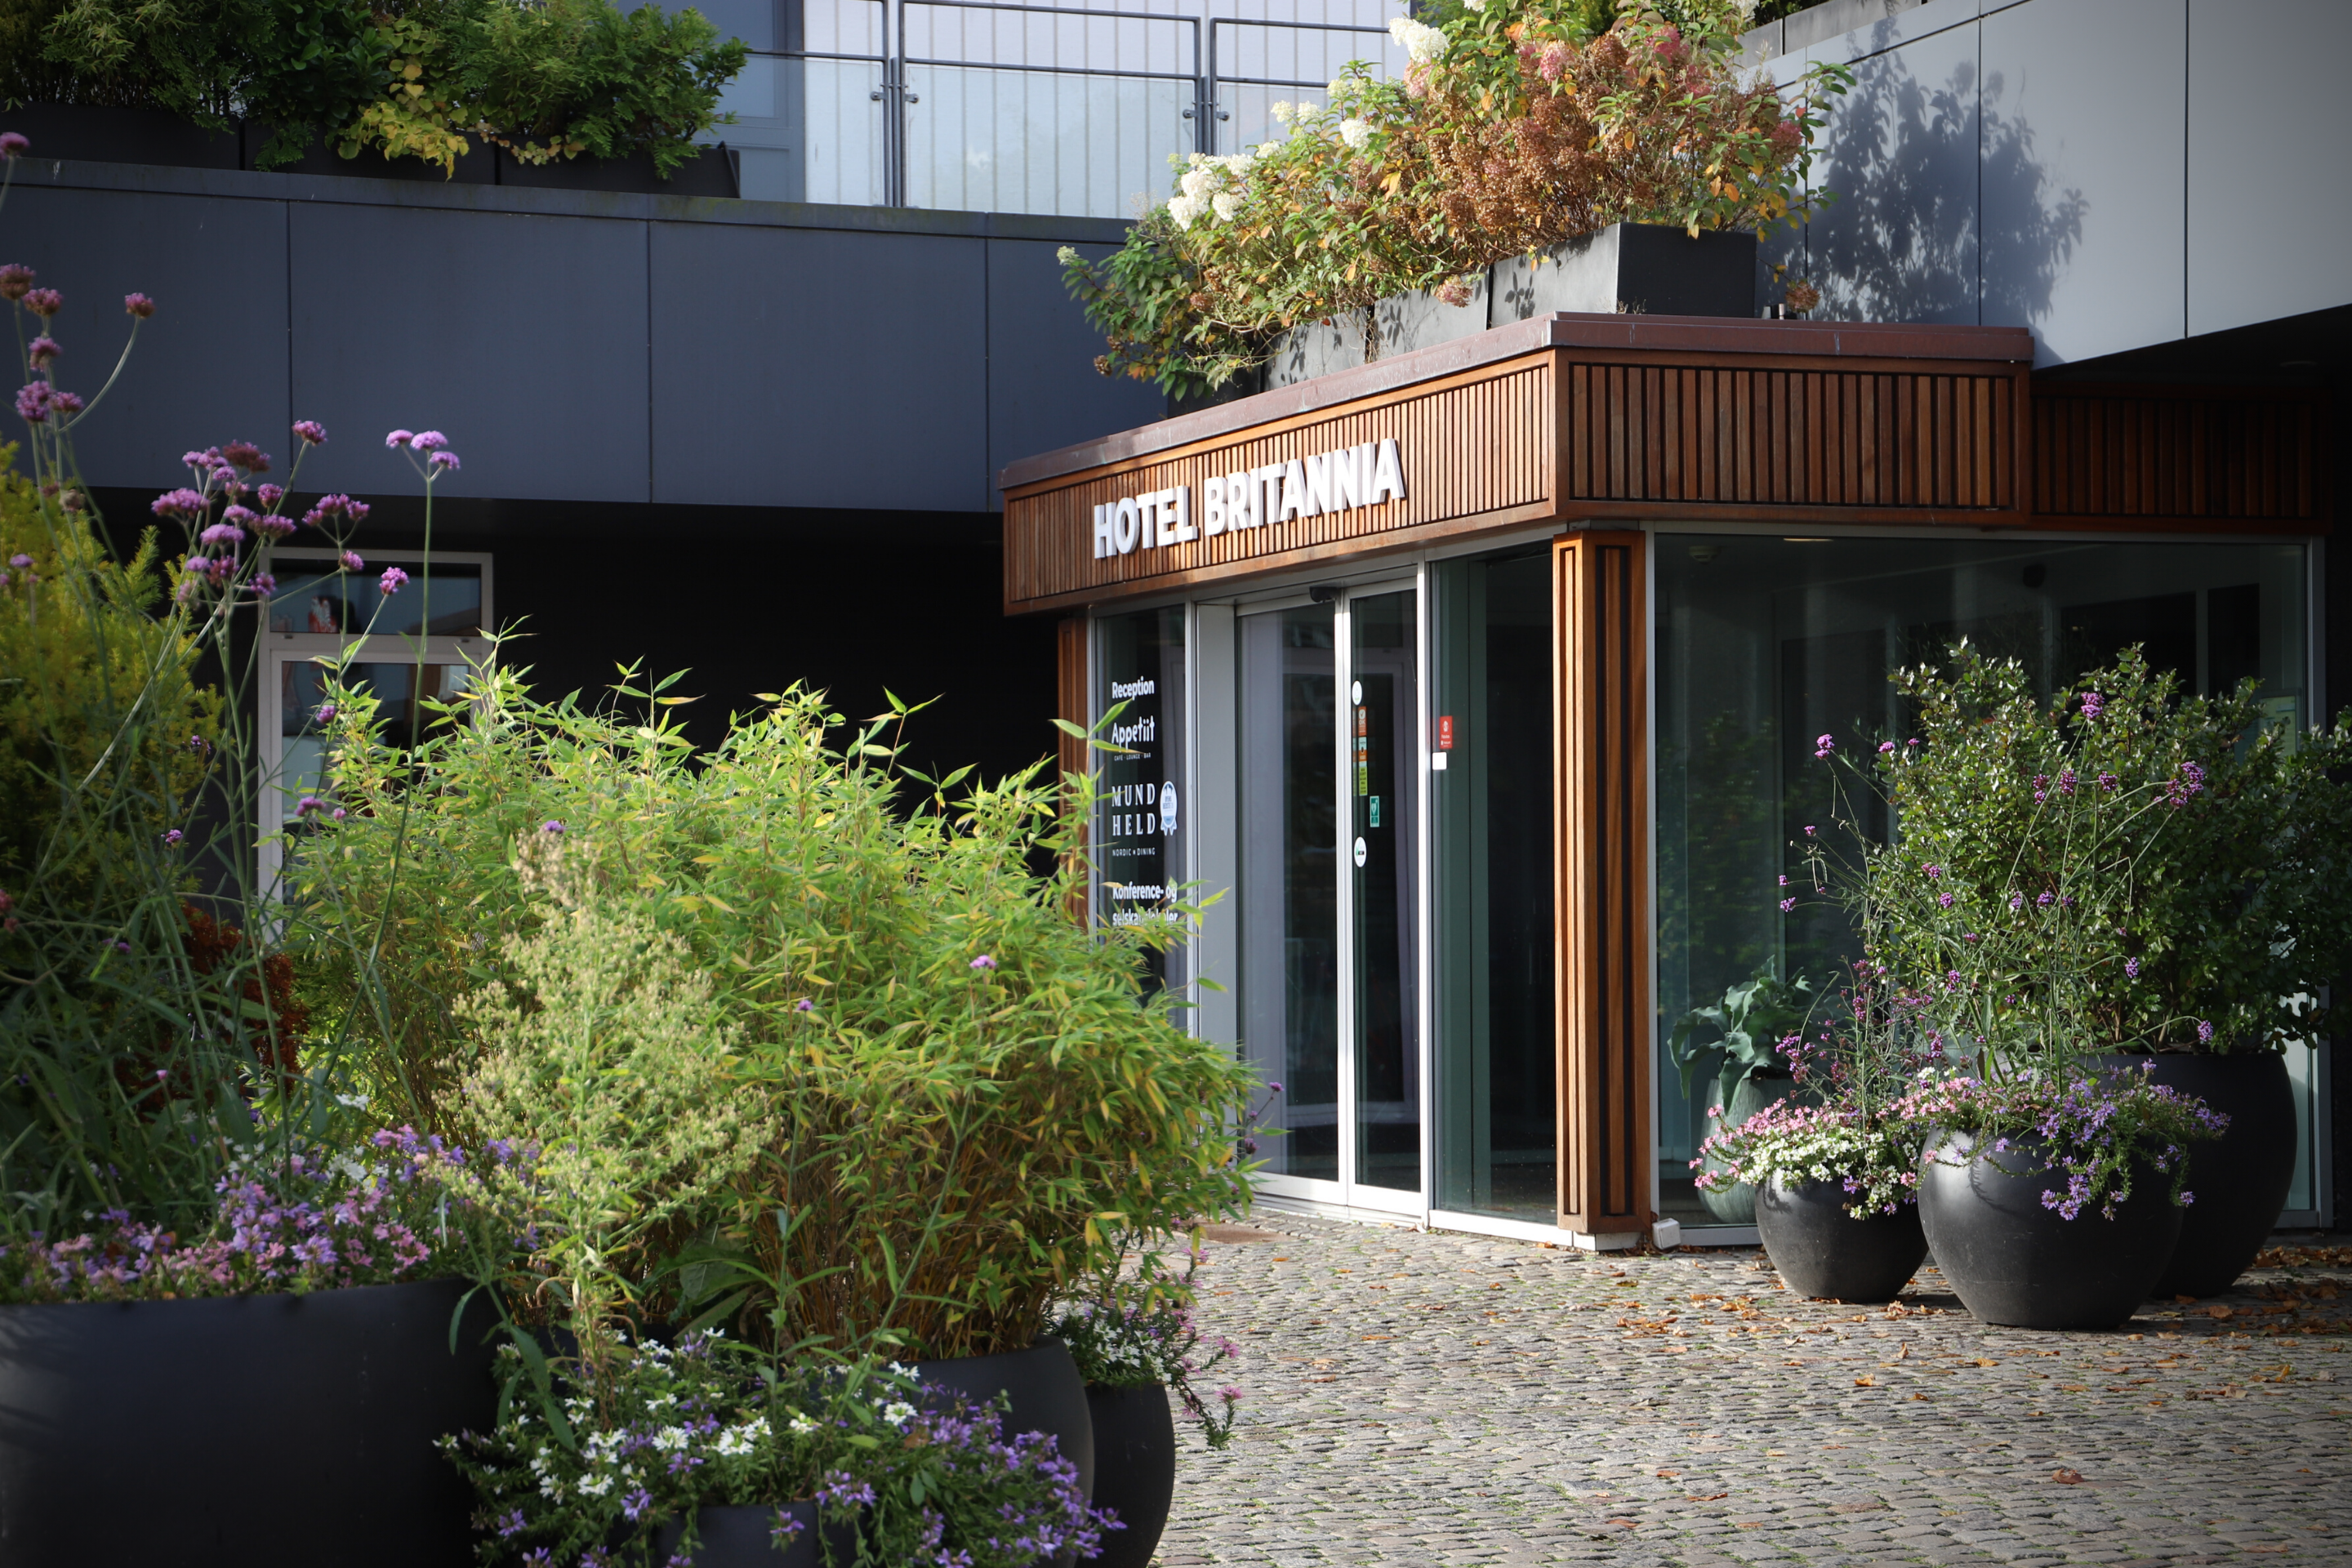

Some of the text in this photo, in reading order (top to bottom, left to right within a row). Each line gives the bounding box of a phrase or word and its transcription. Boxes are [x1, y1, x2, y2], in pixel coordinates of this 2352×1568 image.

[1094, 438, 1405, 559] HOTEL BRITANNIA
[1111, 675, 1155, 701] Reception
[1111, 782, 1156, 807] MUND
[1112, 813, 1156, 836] HELD
[1112, 847, 1156, 857] NORDIC DINING
[1112, 880, 1178, 903] Konference- og
